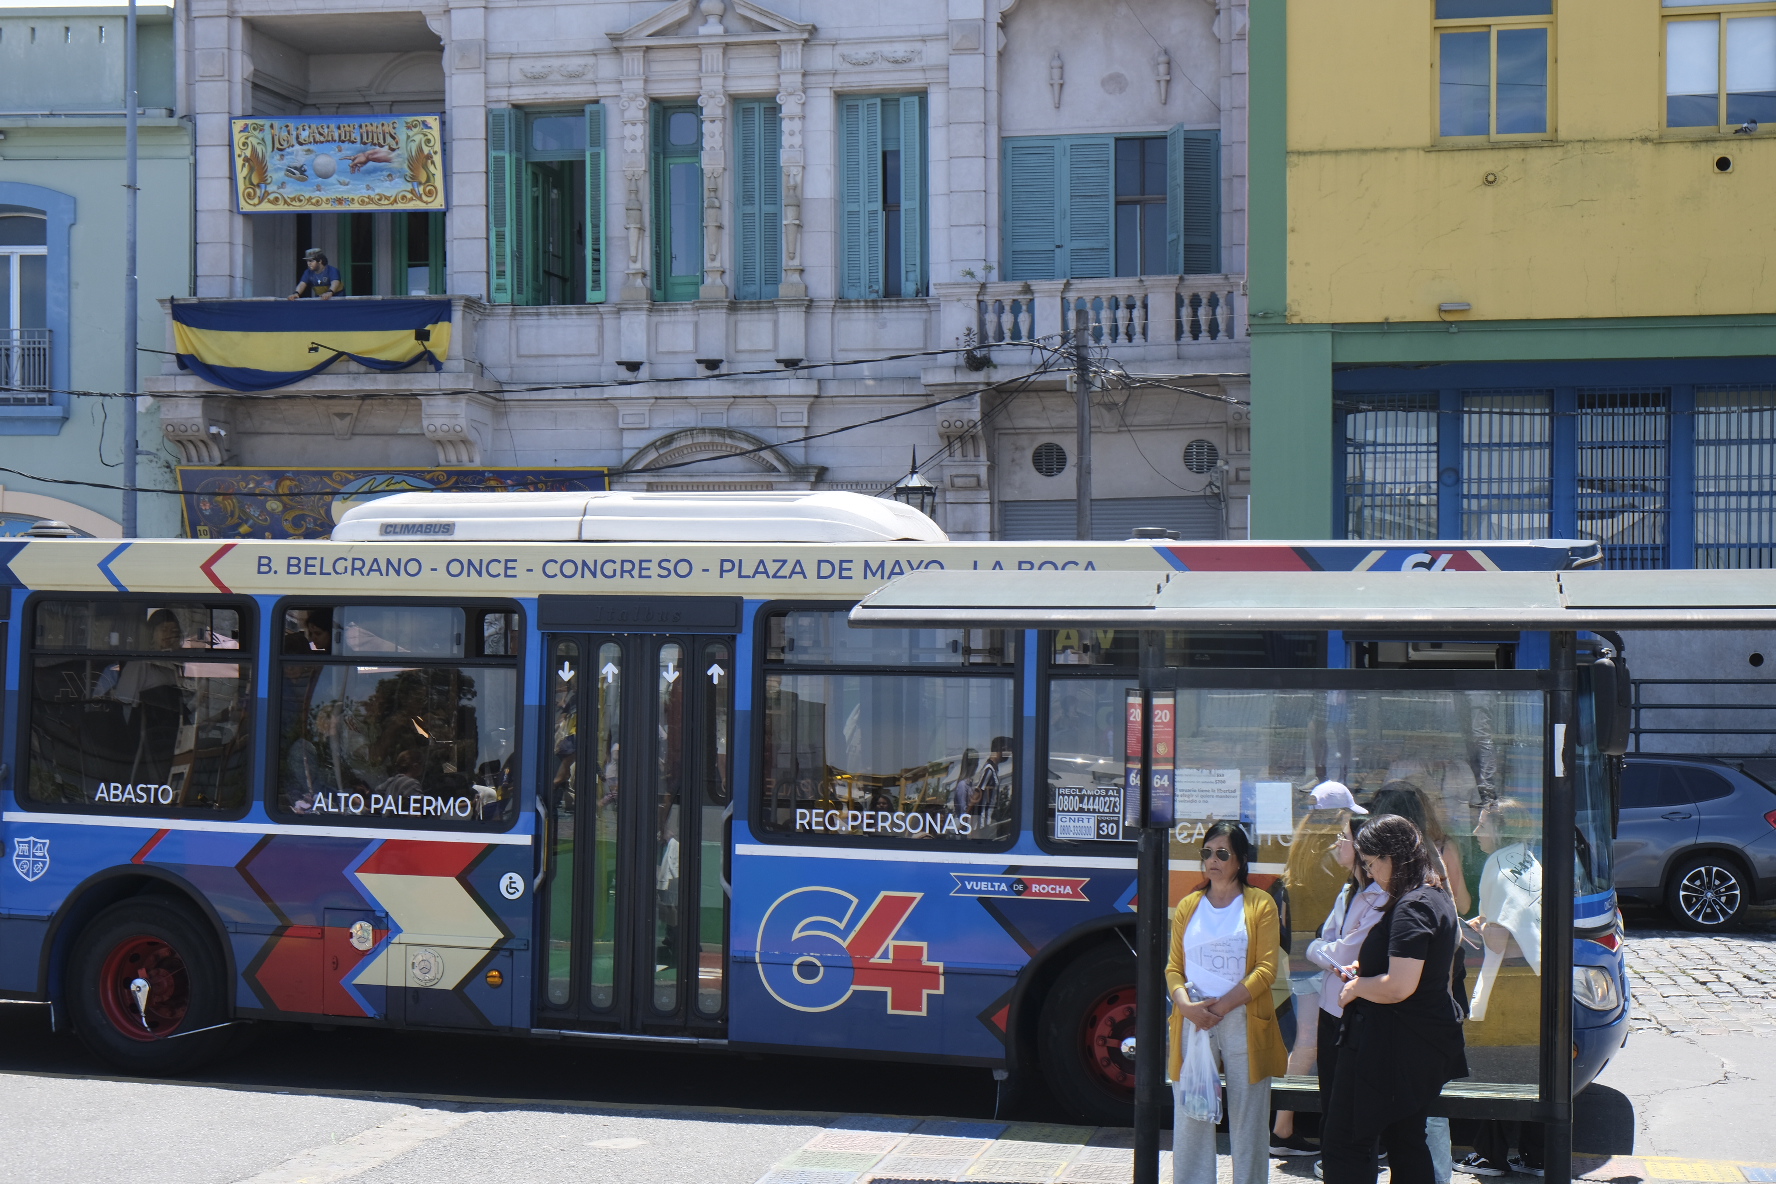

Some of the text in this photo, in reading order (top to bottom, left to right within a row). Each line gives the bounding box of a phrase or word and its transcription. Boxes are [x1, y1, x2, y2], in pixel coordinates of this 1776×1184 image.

[296, 123, 337, 146] CASA
[338, 124, 359, 144] DE
[360, 121, 400, 151] DIOS
[198, 529, 208, 537] 10
[384, 523, 451, 535] CLIMABUS
[256, 555, 278, 575] B.
[286, 556, 423, 577] BELGRANO
[445, 557, 518, 579] ONCE
[541, 558, 694, 580] CONGRESO
[718, 558, 808, 580] PLAZA
[816, 558, 853, 580] DE
[863, 559, 945, 580] MAYO
[593, 605, 683, 624] Italbus
[1129, 708, 1141, 722] 20
[1154, 709, 1170, 723] 20
[1129, 773, 1141, 786] 64
[1153, 774, 1170, 788] 64
[95, 782, 173, 804] ABASTO
[312, 791, 472, 817] ALTO PALERMO
[1058, 795, 1120, 813] 0800-4440273
[795, 808, 972, 835] REG.PERSONAS
[1099, 822, 1117, 836] 30
[964, 881, 1008, 891] VUELTA
[1031, 883, 1073, 894] ROCHA
[755, 885, 945, 1017] 64
